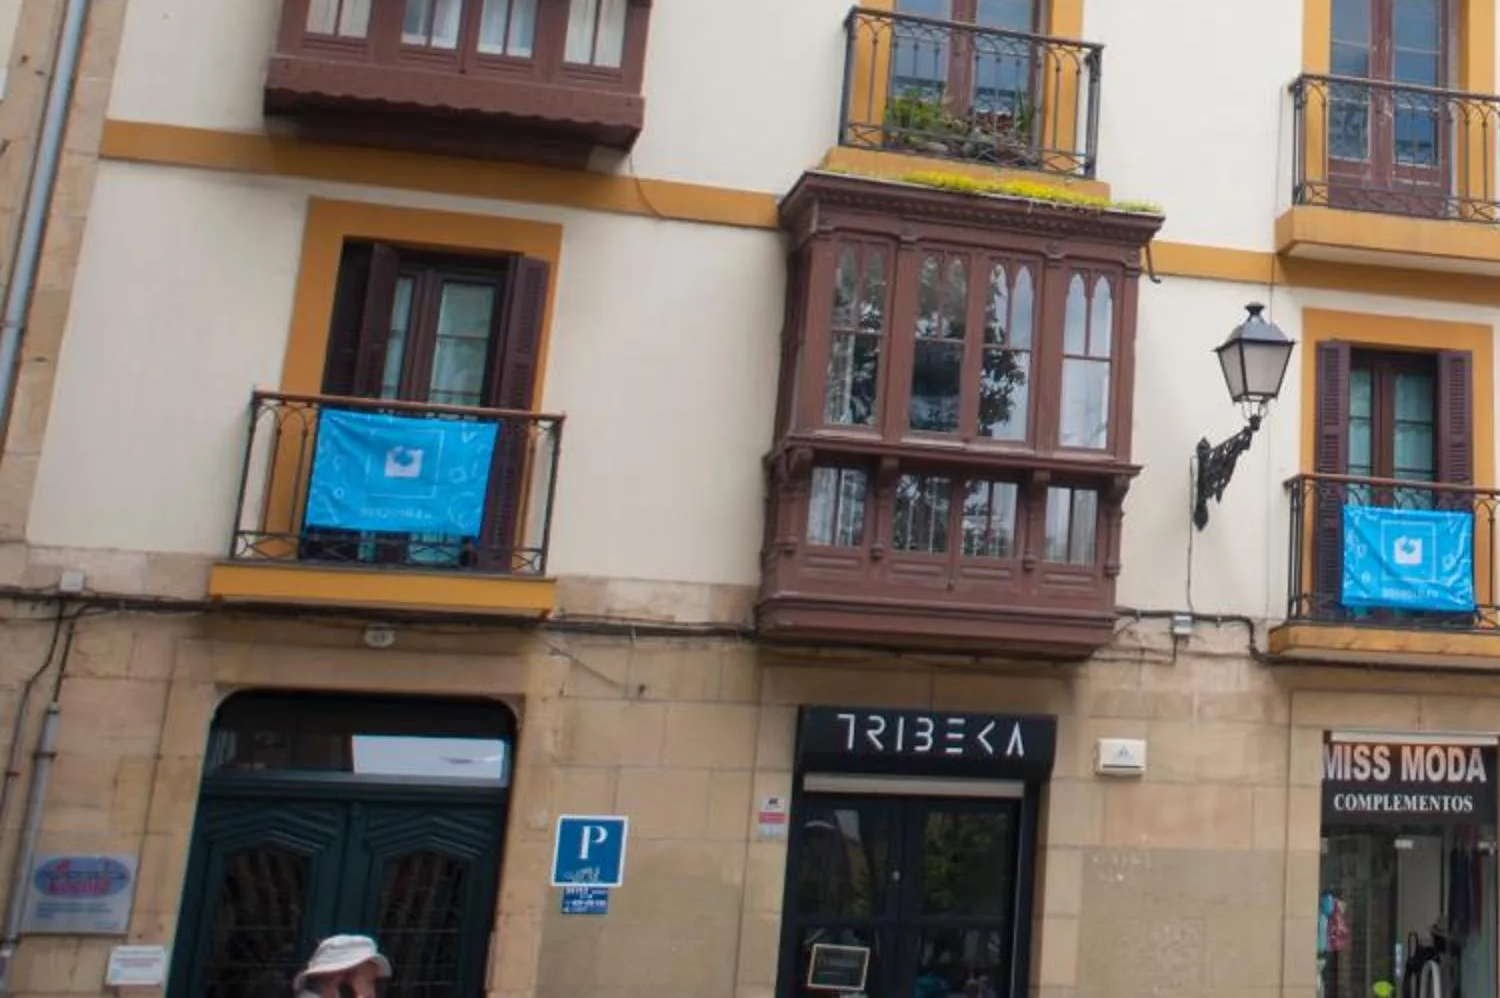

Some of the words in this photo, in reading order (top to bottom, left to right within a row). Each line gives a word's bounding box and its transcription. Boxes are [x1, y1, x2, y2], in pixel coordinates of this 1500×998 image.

[1321, 743, 1391, 782] MISS
[1401, 745, 1487, 783] MODA
[1333, 793, 1473, 813] COMPLEMENTOS
[579, 825, 608, 859] P
